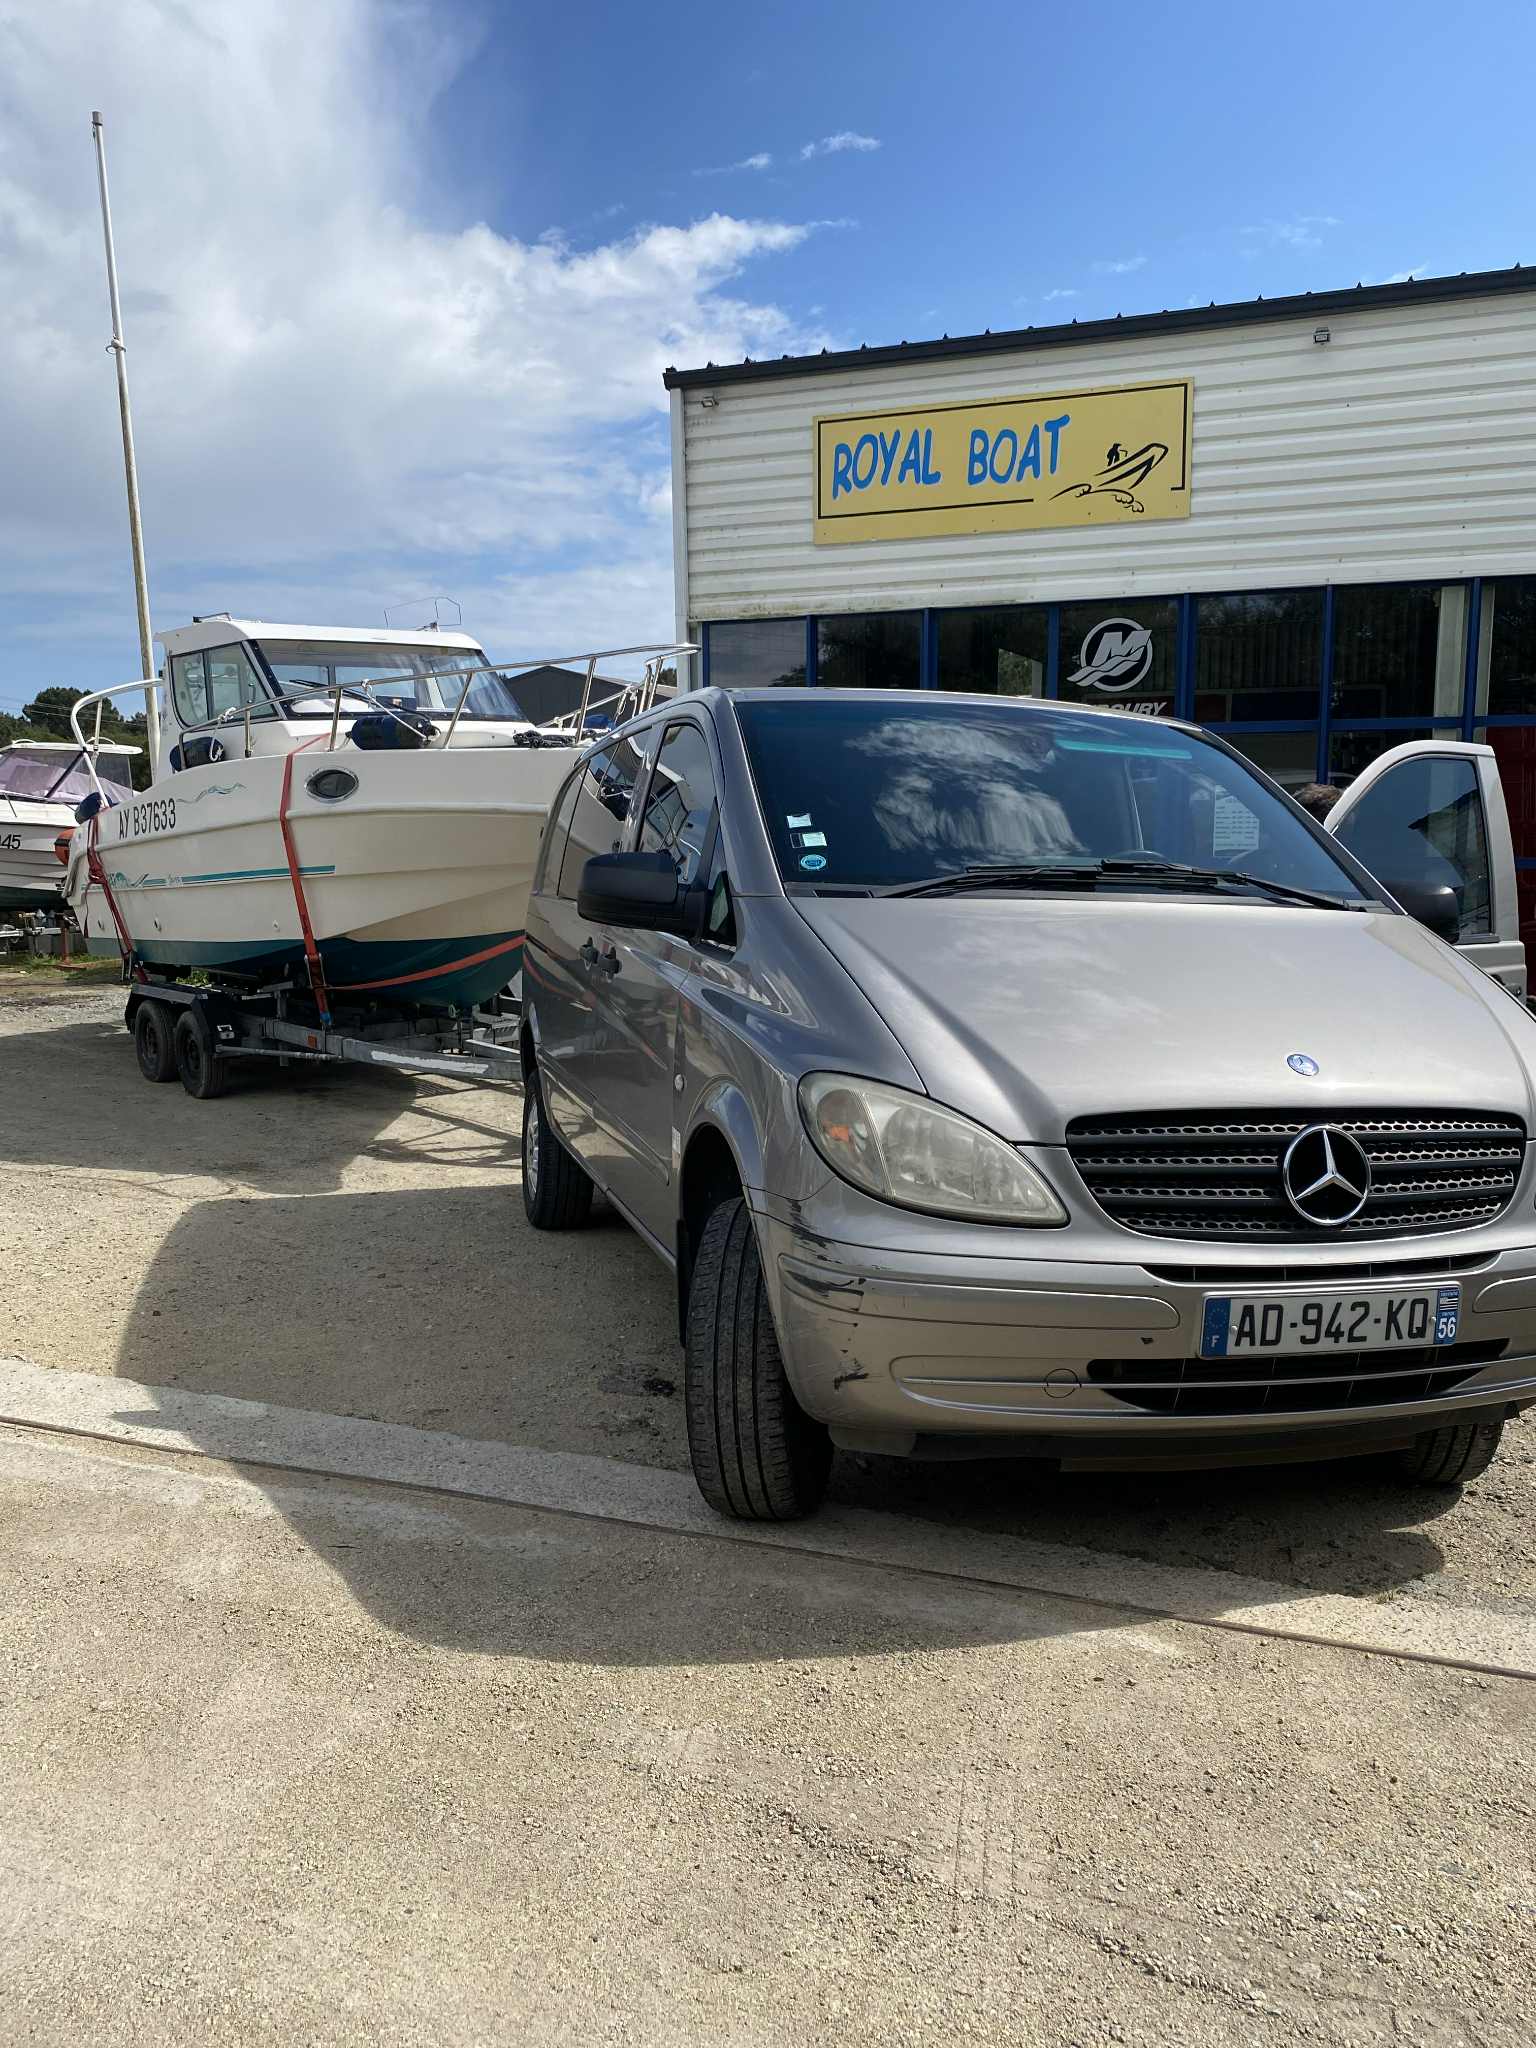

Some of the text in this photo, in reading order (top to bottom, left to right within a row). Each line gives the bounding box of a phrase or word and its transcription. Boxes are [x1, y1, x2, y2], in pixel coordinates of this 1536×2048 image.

[832, 414, 1070, 500] ROYAL BOAT
[119, 798, 176, 841] AY B37633
[0, 833, 21, 850] 45
[1234, 1297, 1430, 1347] AD-942-KQ
[1437, 1316, 1457, 1339] 56
[1210, 1334, 1220, 1349] F
